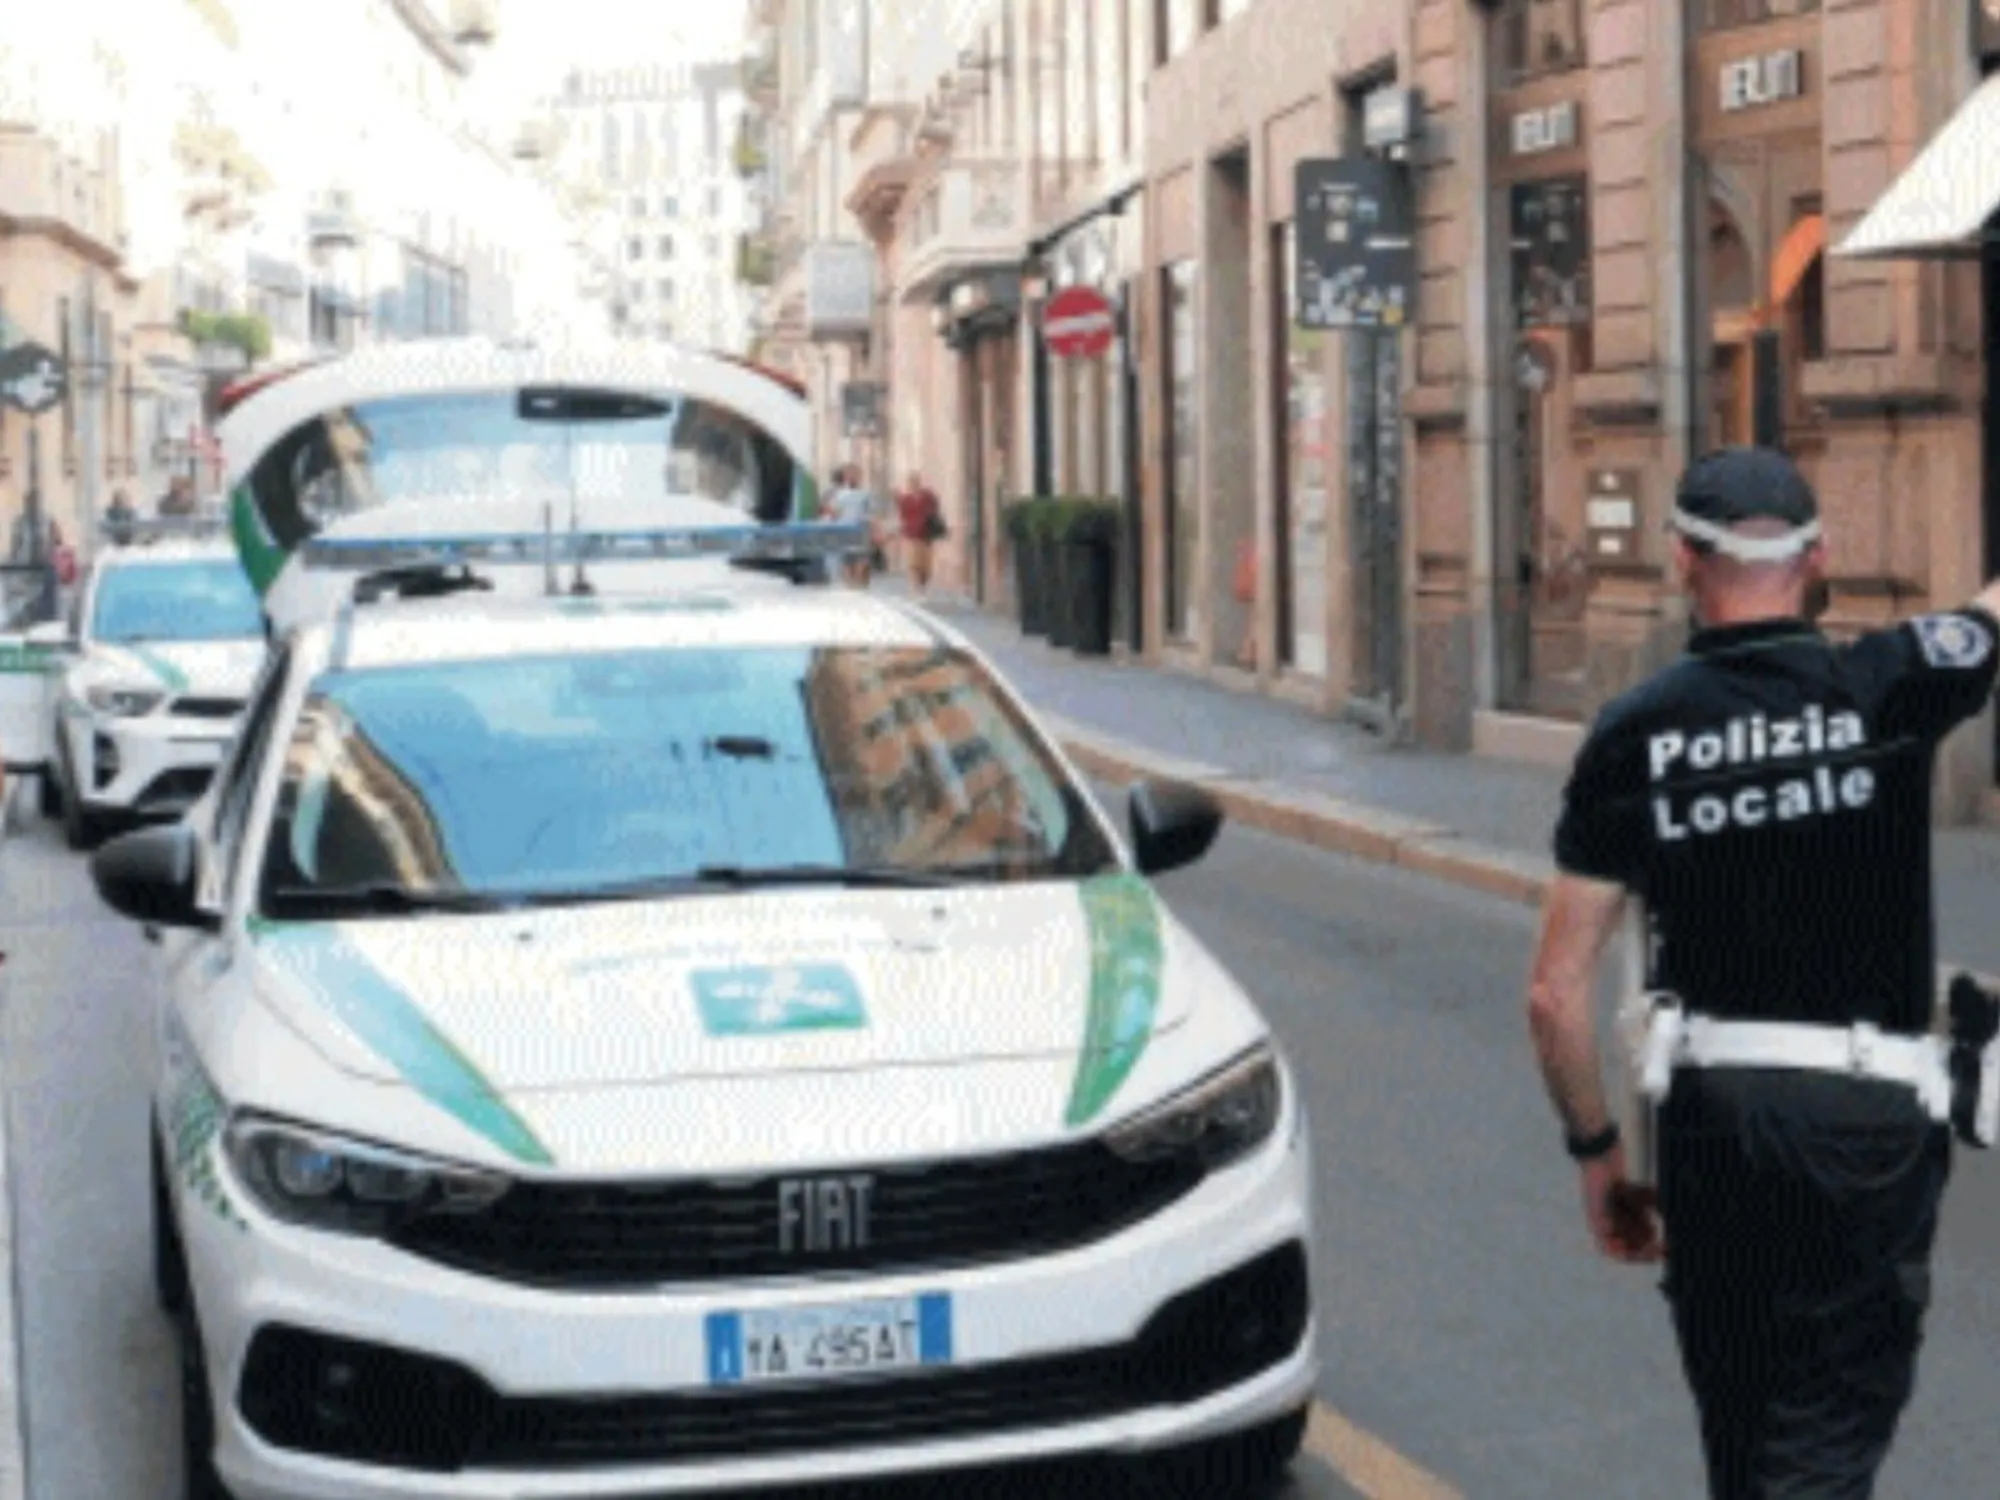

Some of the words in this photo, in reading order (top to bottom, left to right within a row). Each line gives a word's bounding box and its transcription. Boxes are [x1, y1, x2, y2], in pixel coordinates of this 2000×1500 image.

[1648, 703, 1865, 780] Polizia
[1653, 766, 1875, 841] Locale
[778, 1174, 873, 1254] FIAT
